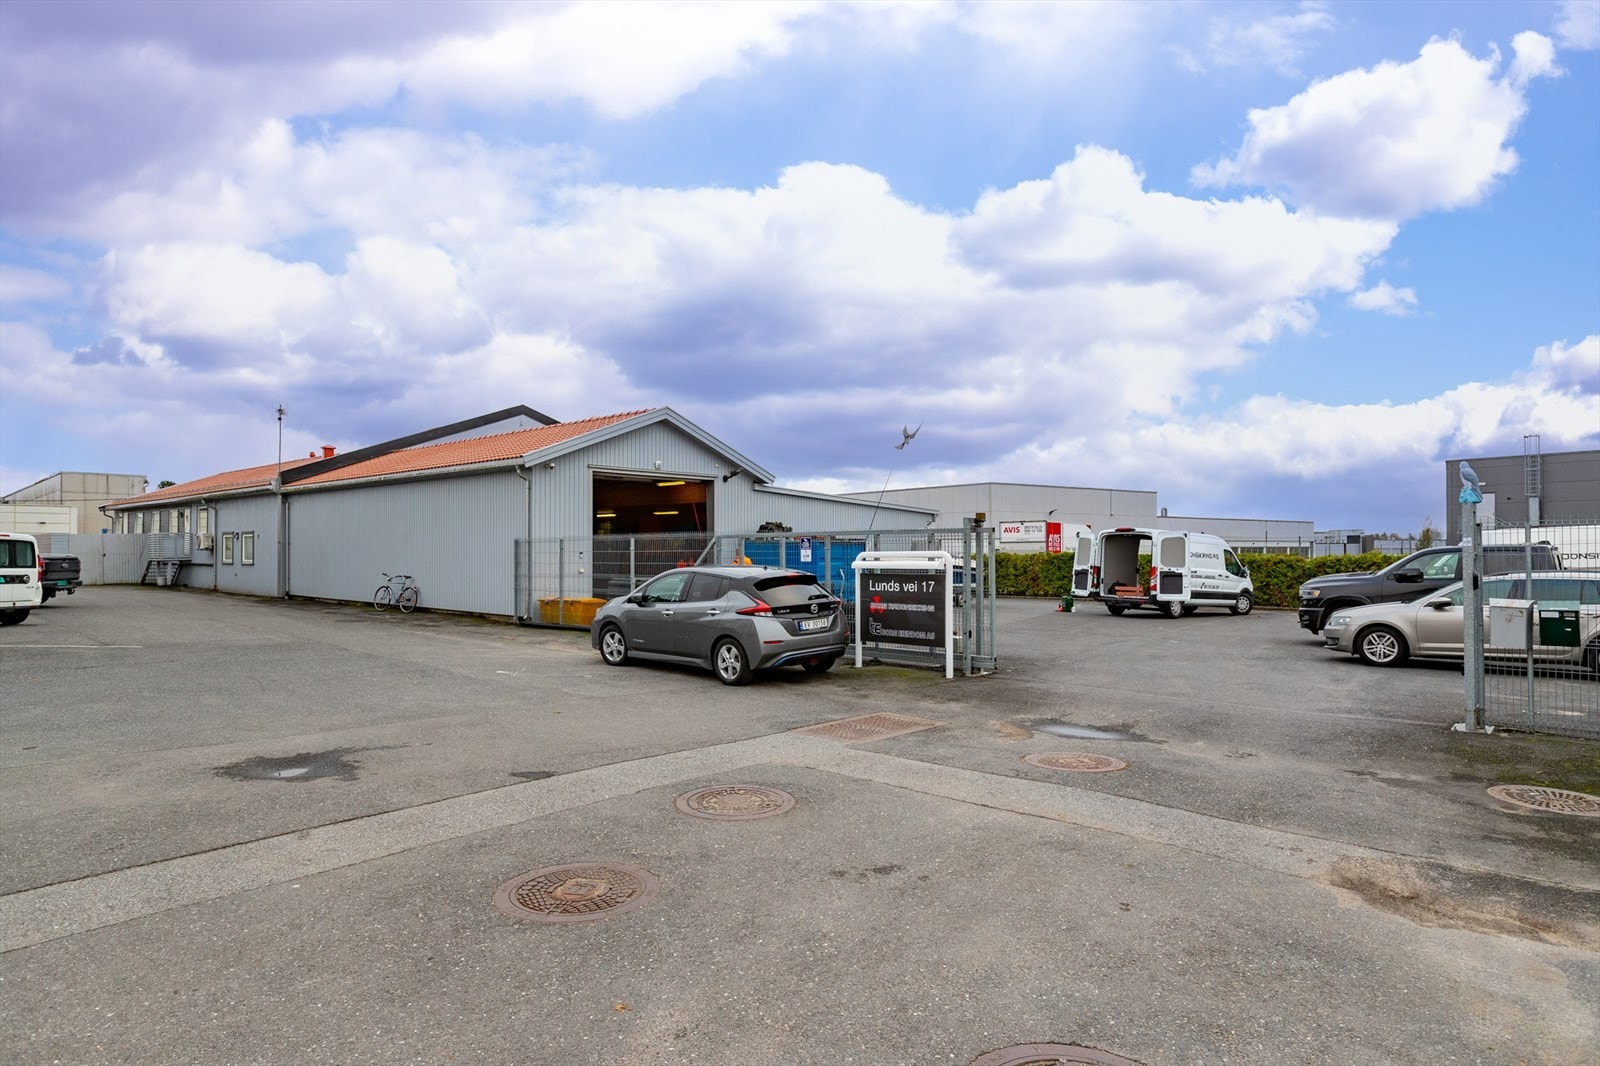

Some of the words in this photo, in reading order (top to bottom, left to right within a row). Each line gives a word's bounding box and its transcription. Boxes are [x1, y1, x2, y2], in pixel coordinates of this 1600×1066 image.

[869, 580, 900, 592] Lunds
[903, 581, 918, 592] vei
[922, 581, 935, 592] 17
